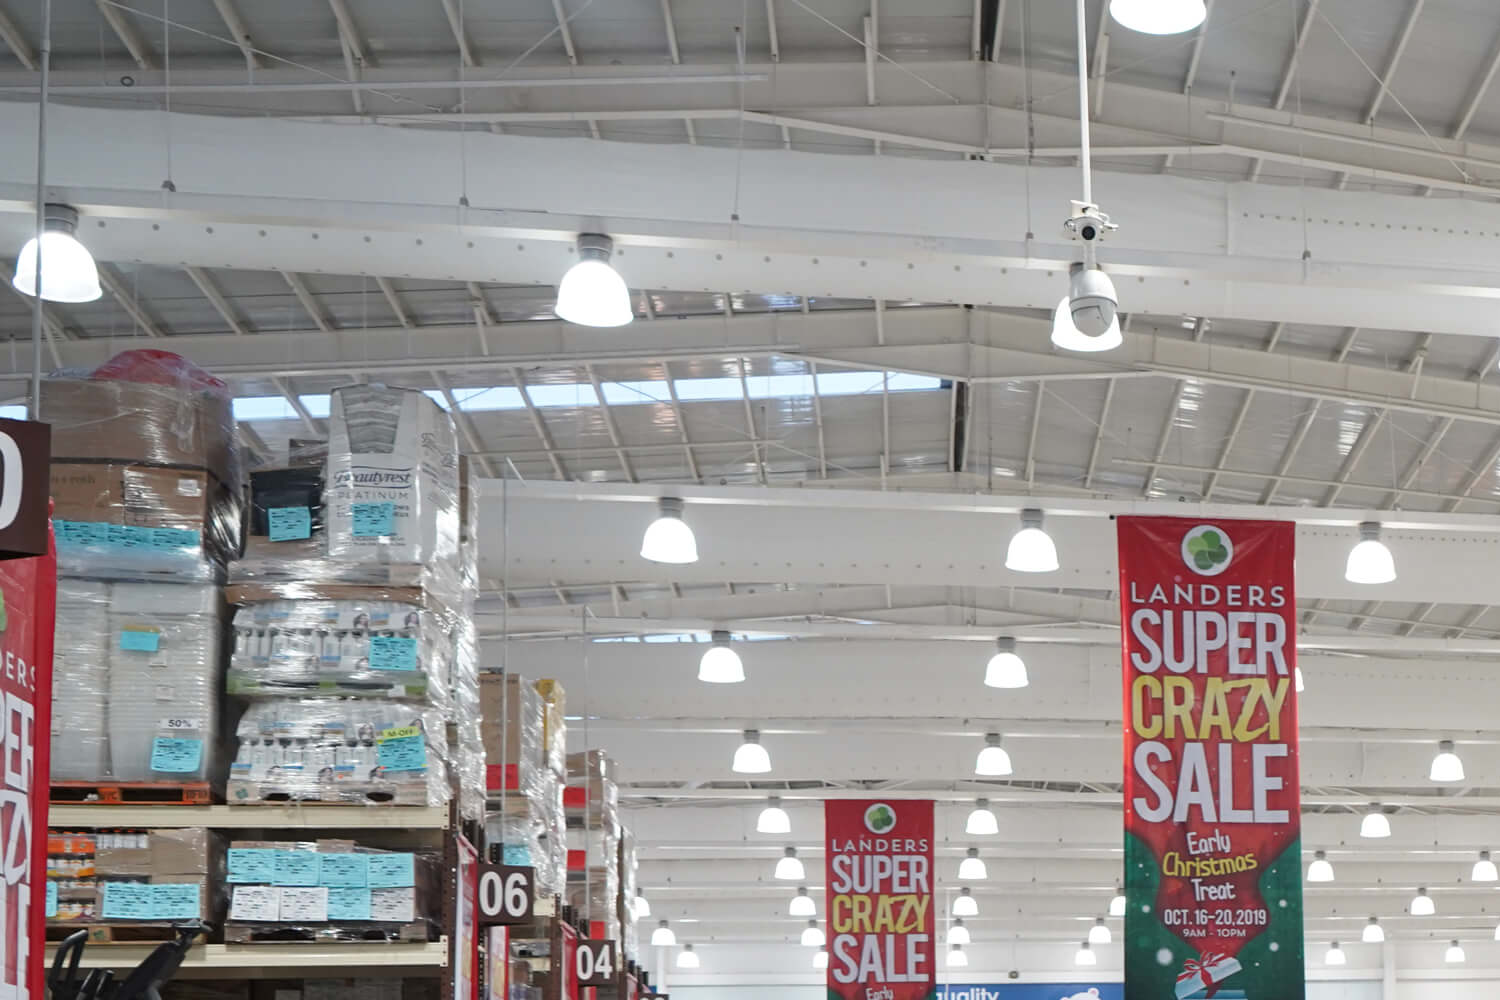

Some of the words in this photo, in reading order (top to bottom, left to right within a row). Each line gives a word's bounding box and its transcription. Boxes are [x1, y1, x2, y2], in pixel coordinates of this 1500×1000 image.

[334, 470, 412, 485] Beautyrest
[337, 491, 409, 500] PLATINUM
[1131, 581, 1286, 607] LANDERS
[1130, 608, 1288, 675] SUPER
[1131, 675, 1290, 742] CRAZY
[168, 719, 192, 728] 50%
[1132, 741, 1289, 824] SALE
[832, 839, 928, 852] LANDERS
[1186, 829, 1231, 856] Early
[831, 855, 929, 894] SUPER
[1162, 852, 1257, 877] Christmas
[479, 871, 528, 917] 06
[1191, 878, 1236, 902] Treat
[832, 894, 930, 933] CRAZY
[1164, 909, 1193, 925] OCT.
[1194, 909, 1267, 927] 16-20,2019
[1183, 929, 1206, 937] 9AM
[1217, 929, 1246, 937] 10PM
[576, 944, 613, 981] 04
[832, 933, 929, 984] SALE
